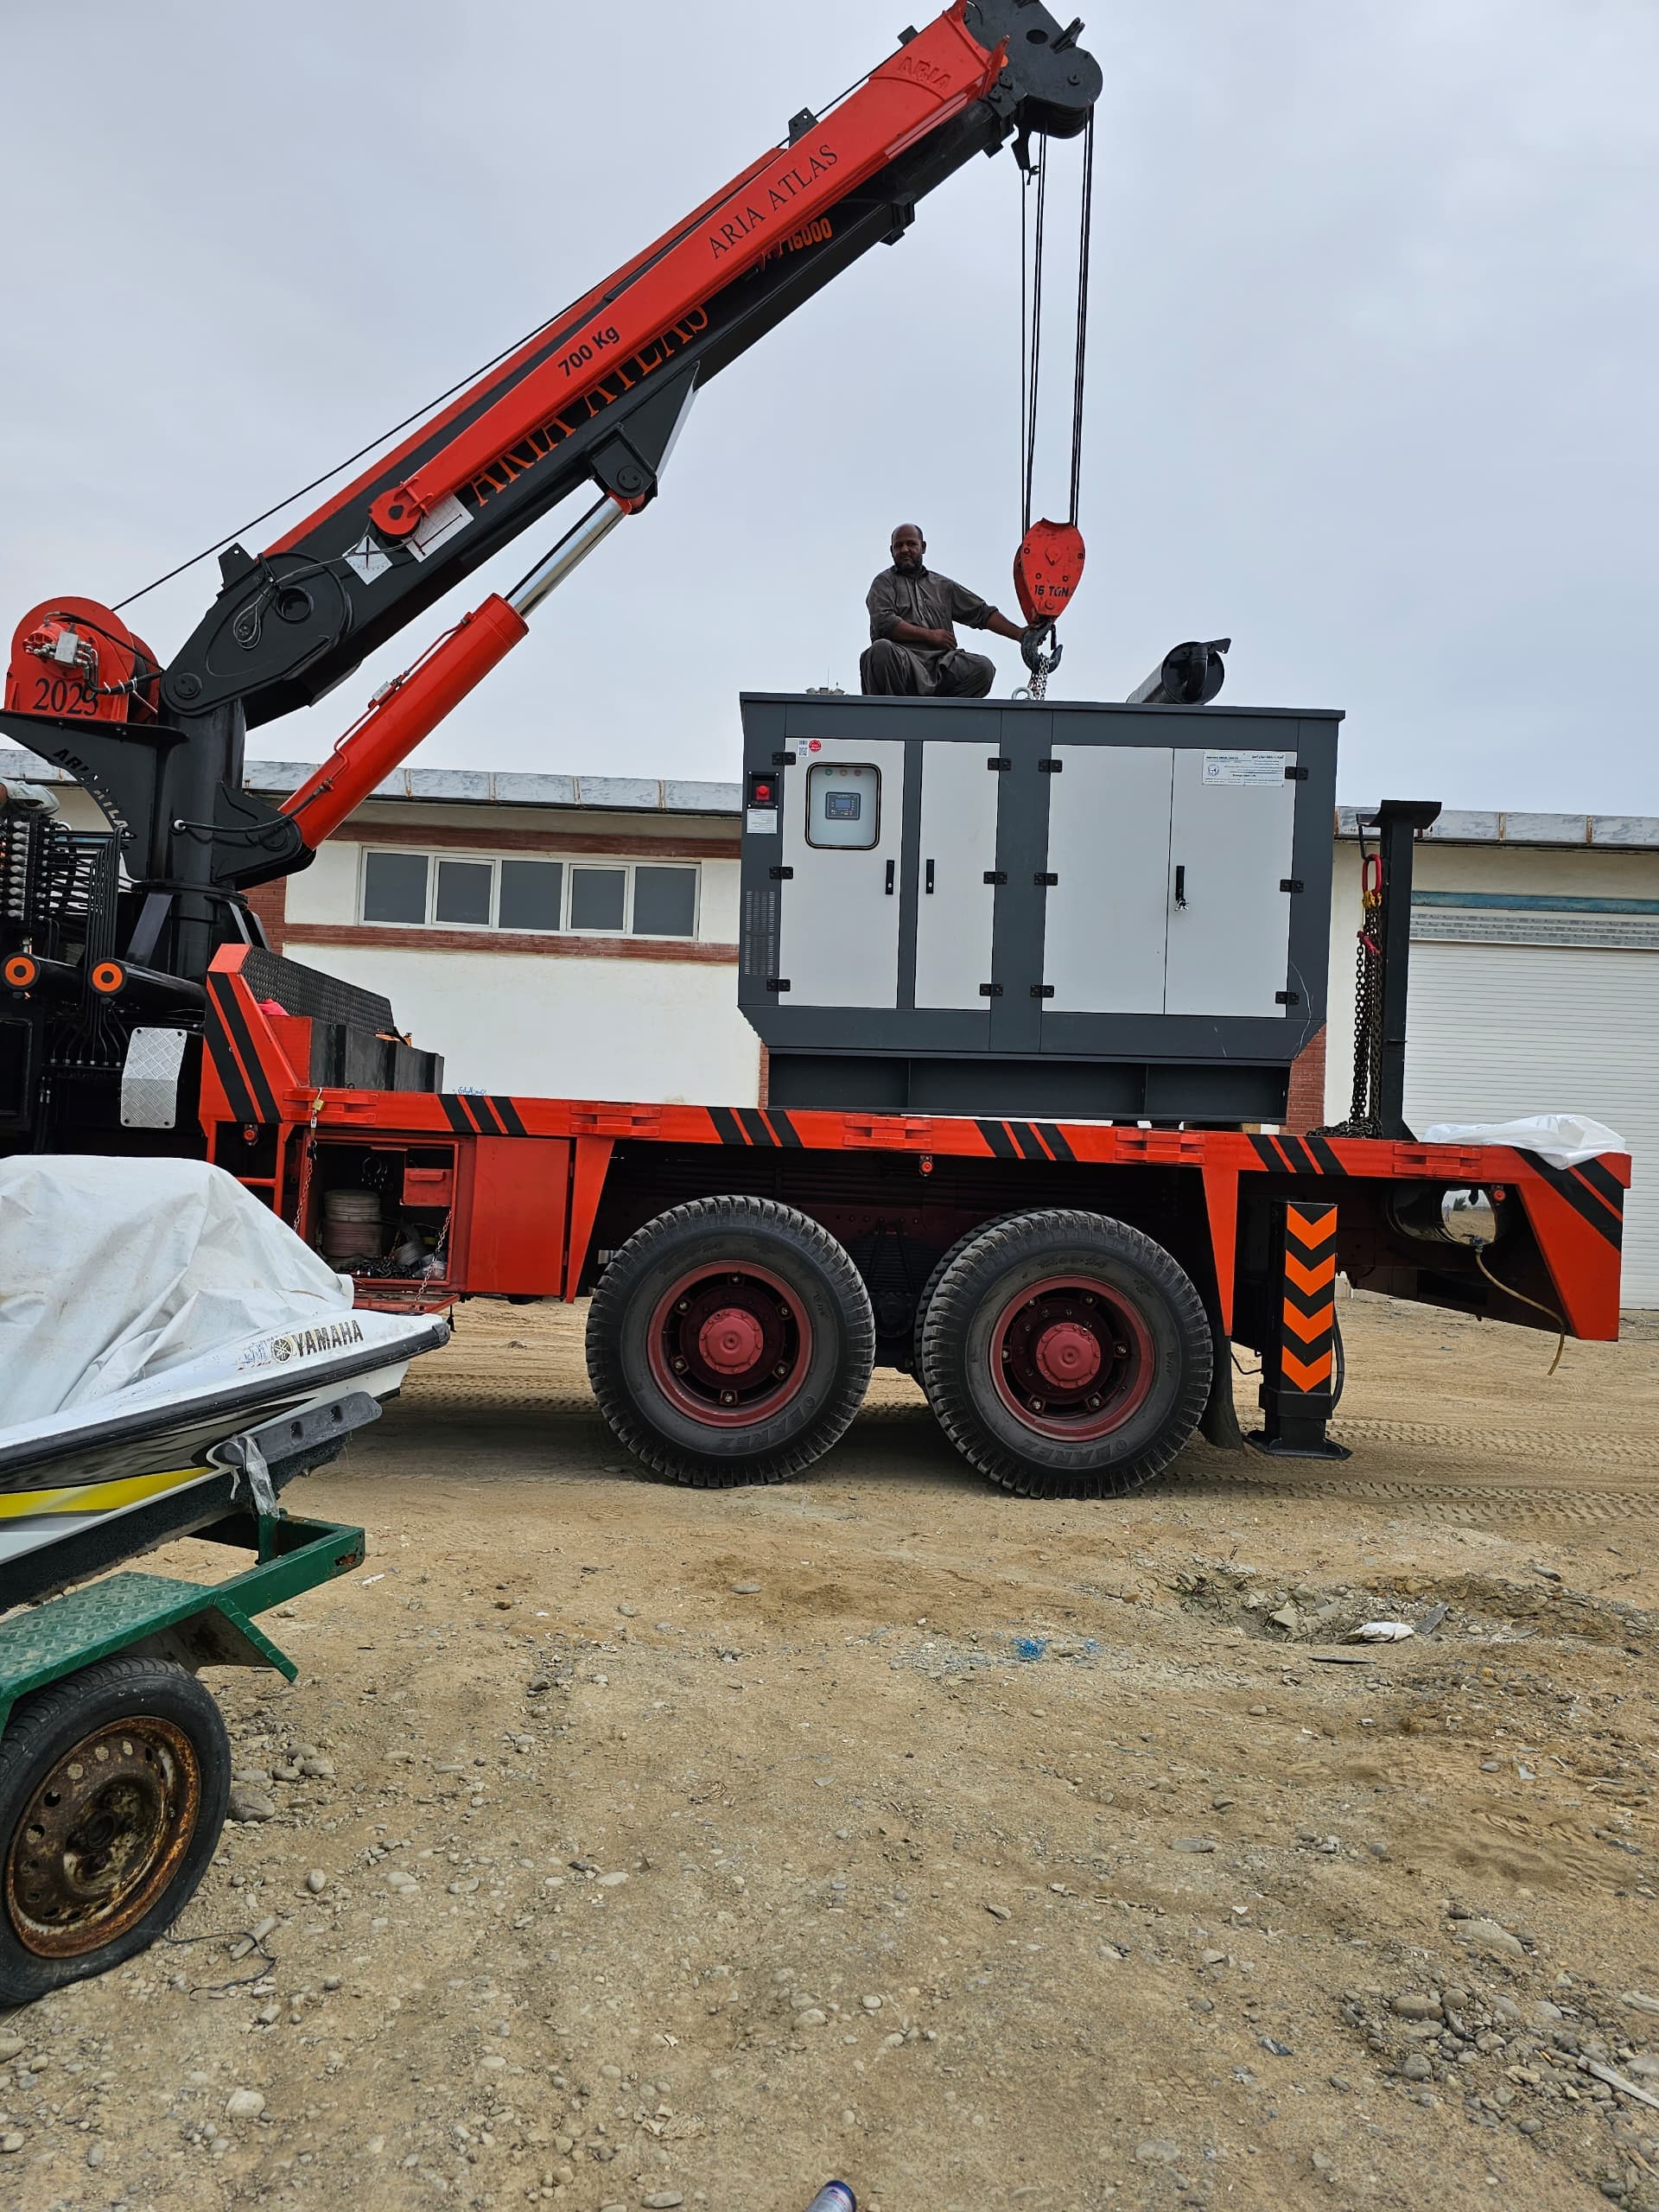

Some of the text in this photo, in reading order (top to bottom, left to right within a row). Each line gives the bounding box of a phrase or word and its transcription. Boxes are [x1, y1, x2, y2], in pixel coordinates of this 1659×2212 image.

[709, 207, 766, 259] ARIA
[767, 143, 838, 212] ATLAS
[557, 326, 620, 378] 700 Kg
[1034, 584, 1069, 598] 16 TON
[290, 1319, 364, 1357] YAMAHA
